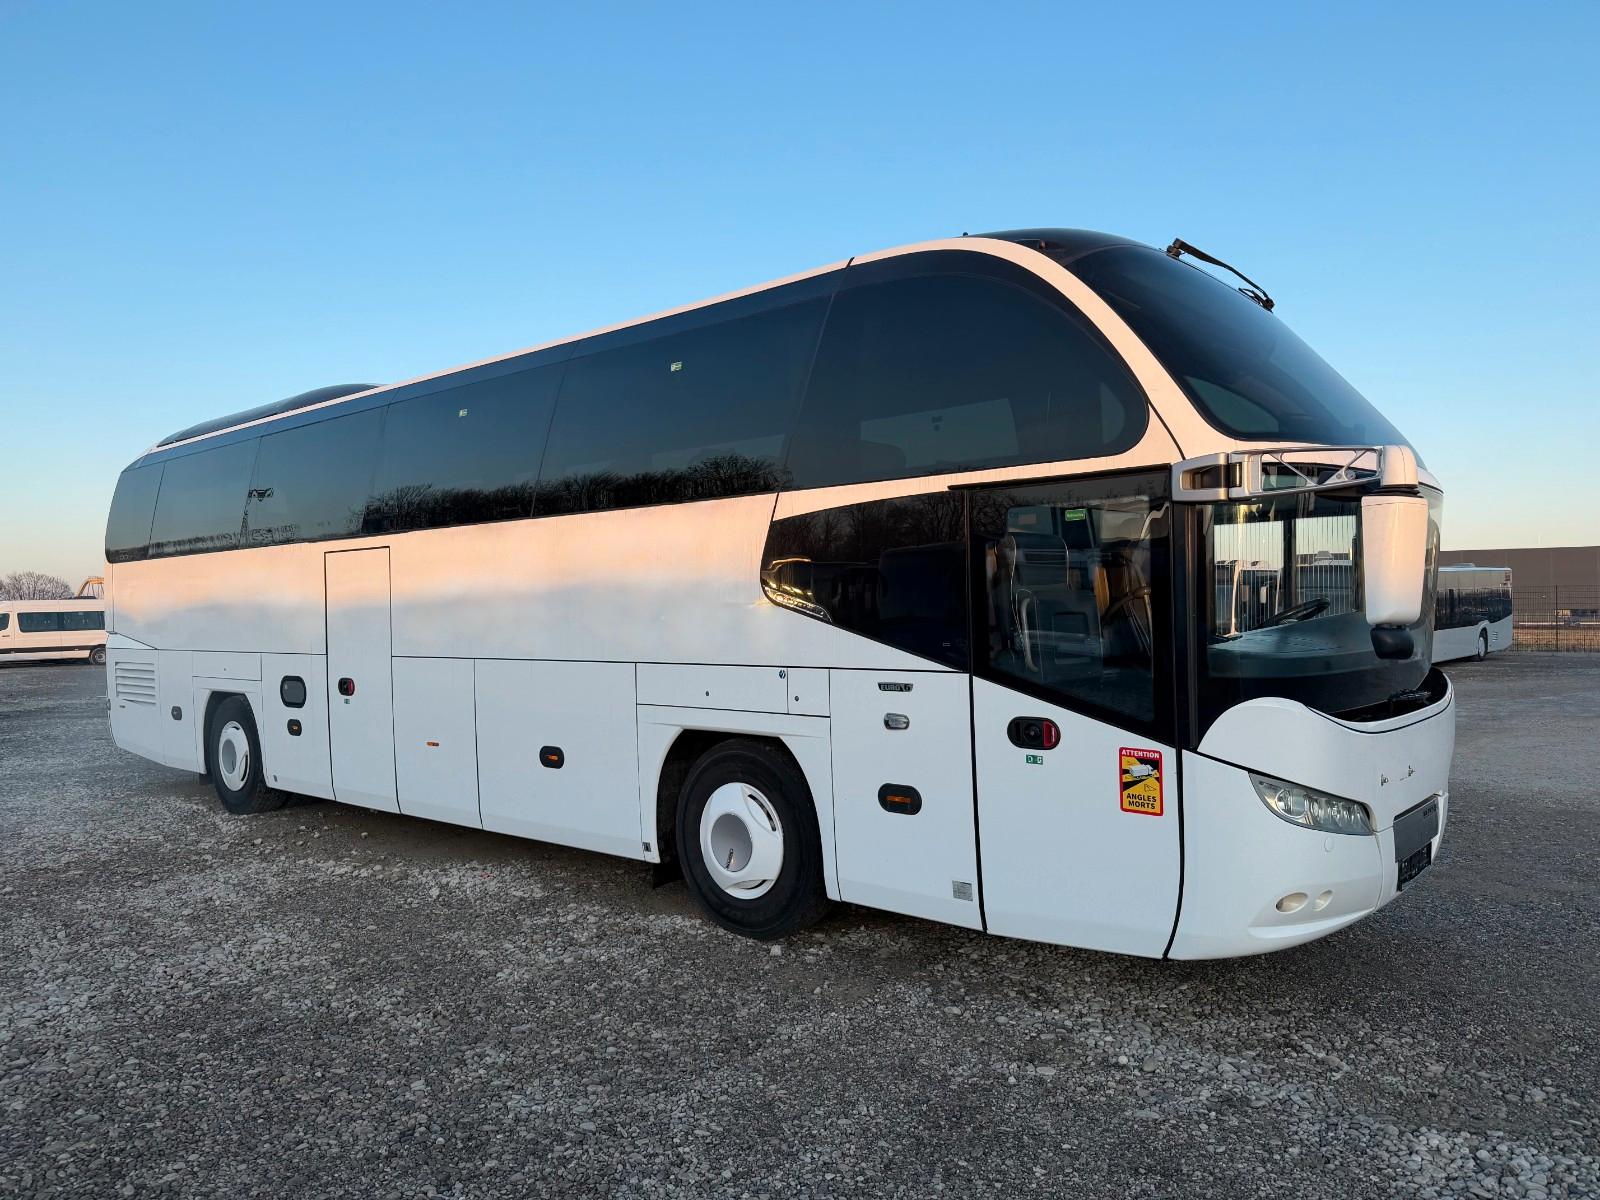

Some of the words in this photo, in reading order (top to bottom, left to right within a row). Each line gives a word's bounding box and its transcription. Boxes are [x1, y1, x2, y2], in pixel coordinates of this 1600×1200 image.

[1121, 749, 1160, 759] ATTENTION
[1126, 792, 1157, 803] ANGLES
[1128, 800, 1156, 809] MORTS
